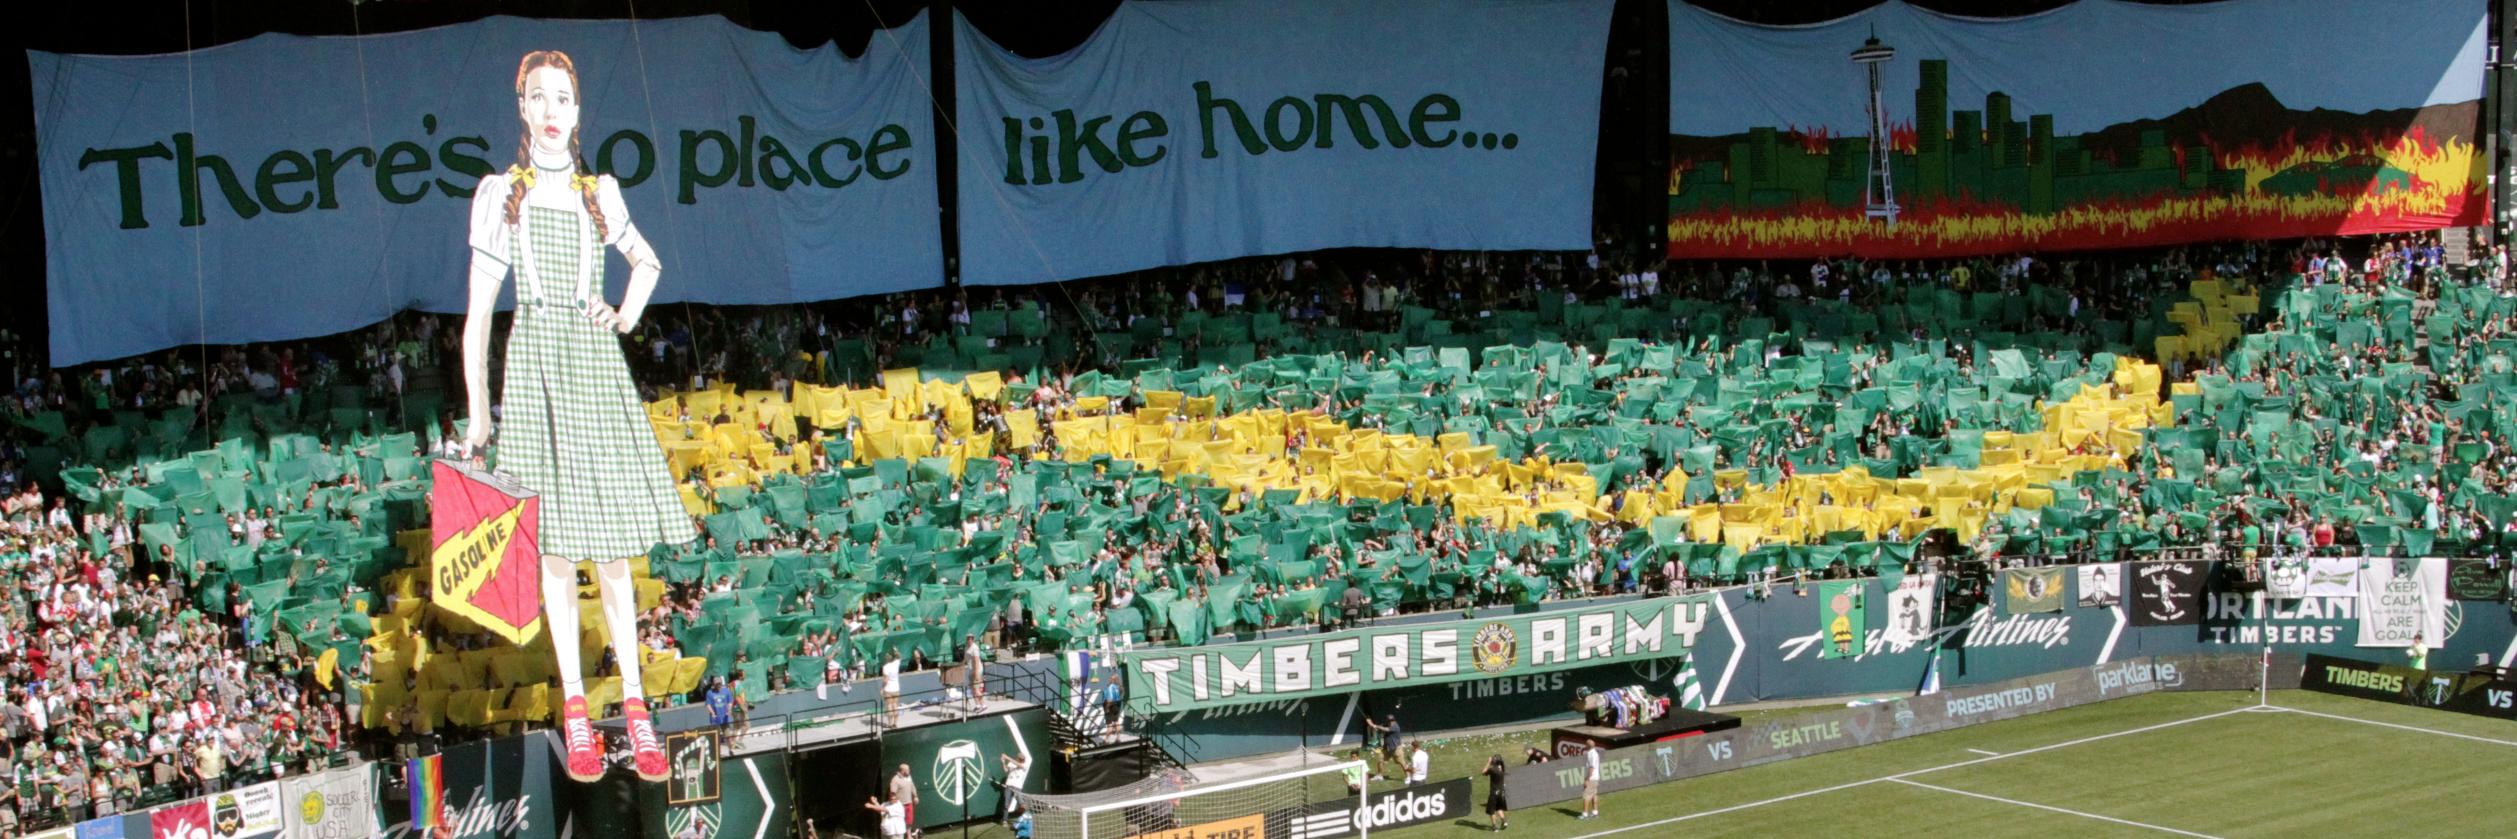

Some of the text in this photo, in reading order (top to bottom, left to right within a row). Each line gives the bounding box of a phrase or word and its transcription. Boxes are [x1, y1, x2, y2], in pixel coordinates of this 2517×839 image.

[1002, 80, 1519, 186] like home...
[78, 112, 912, 230] There's o place
[2206, 590, 2360, 620] ORTLAN
[2380, 594, 2422, 607] CALM
[2385, 581, 2418, 593] KEEP
[2209, 625, 2335, 644] TIMBERS
[2386, 615, 2414, 628] ARE
[1141, 602, 1708, 705] TIMBERS ARMY
[1448, 671, 1565, 701] TIMBERS
[2098, 661, 2176, 696] parklane
[2326, 665, 2513, 709] TIMBERS VS
[1946, 682, 2057, 719] PRESENTED BY
[1555, 720, 1842, 789] TIMERS VS SEATTLE
[1353, 791, 1446, 830] adidas
